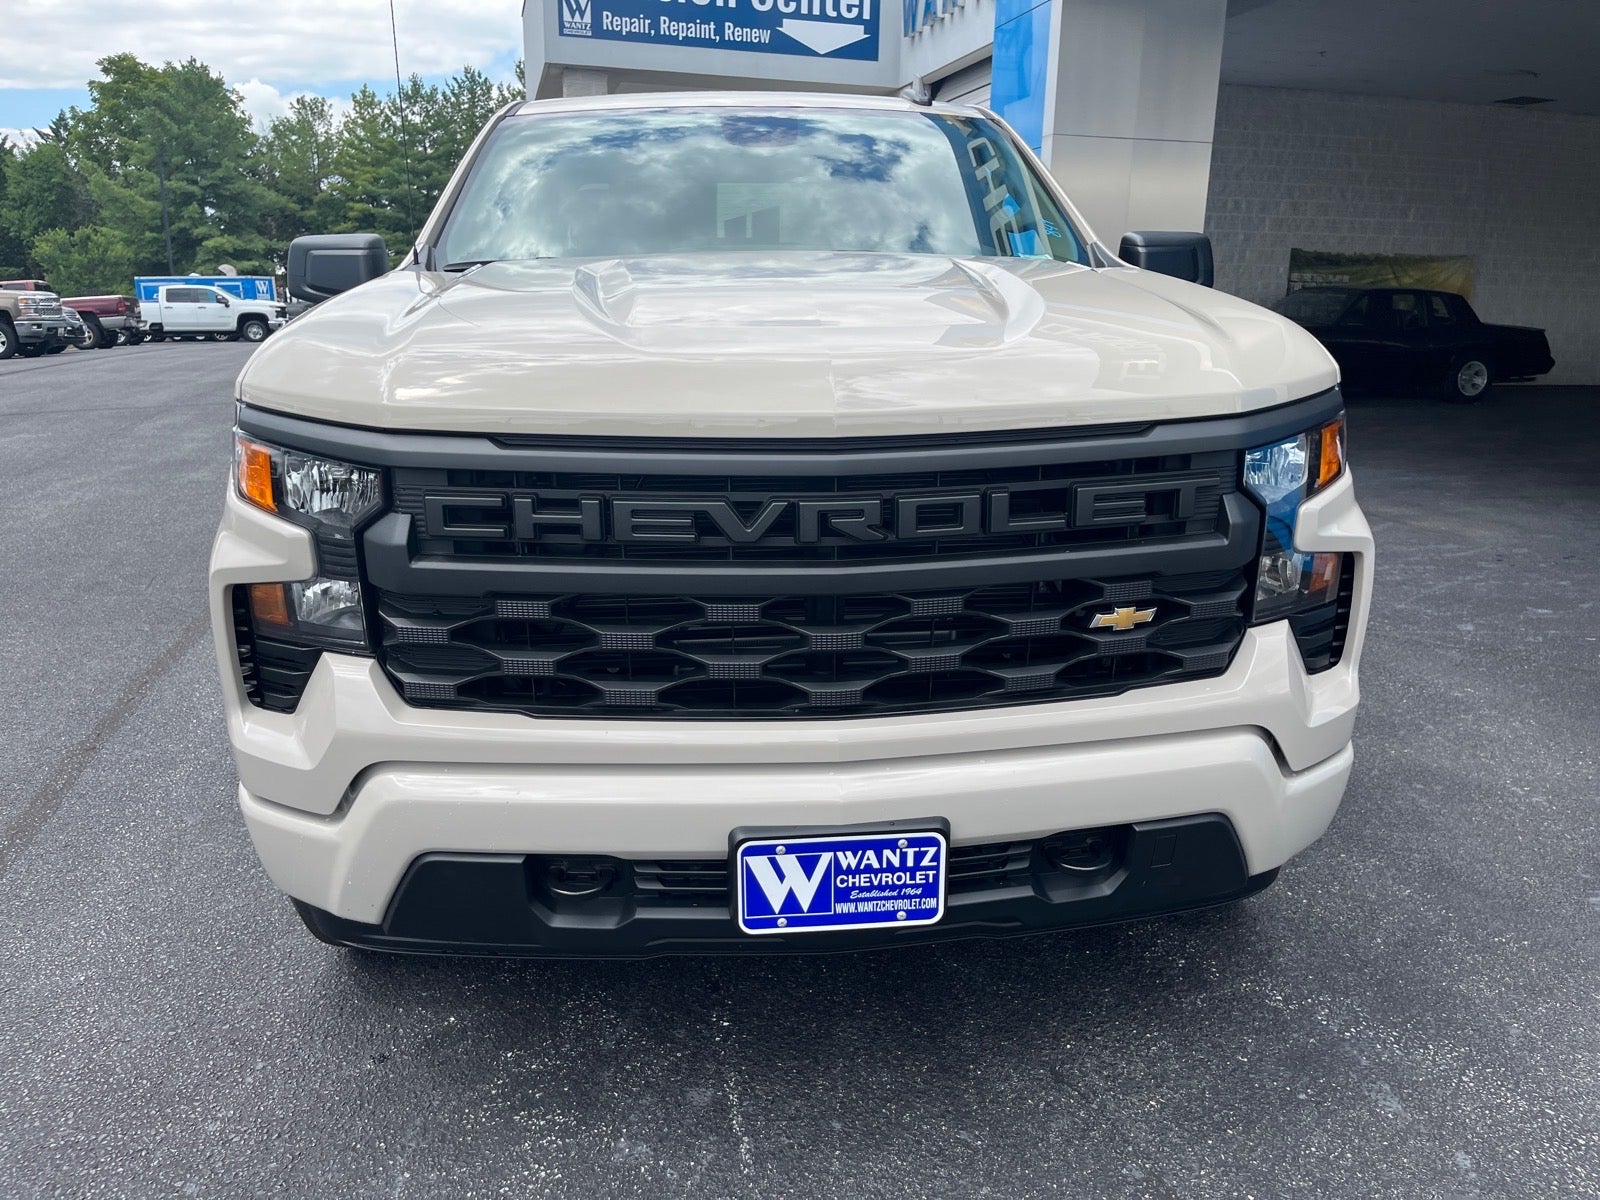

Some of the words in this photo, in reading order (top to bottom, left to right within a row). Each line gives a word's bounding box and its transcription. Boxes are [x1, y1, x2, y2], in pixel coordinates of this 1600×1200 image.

[563, 21, 592, 30] WANTZ
[602, 11, 655, 37] Repair,
[660, 15, 720, 43] Repaint,
[724, 22, 771, 44] Renew
[424, 477, 1220, 544] CHEVROLET
[836, 847, 938, 871] WANTZ
[745, 852, 833, 915] W
[836, 871, 937, 888] CHEVROLET
[849, 888, 899, 899] Established
[901, 887, 923, 896] 1964
[835, 898, 937, 914] WWW.WANTZCHEVROLET.COM
